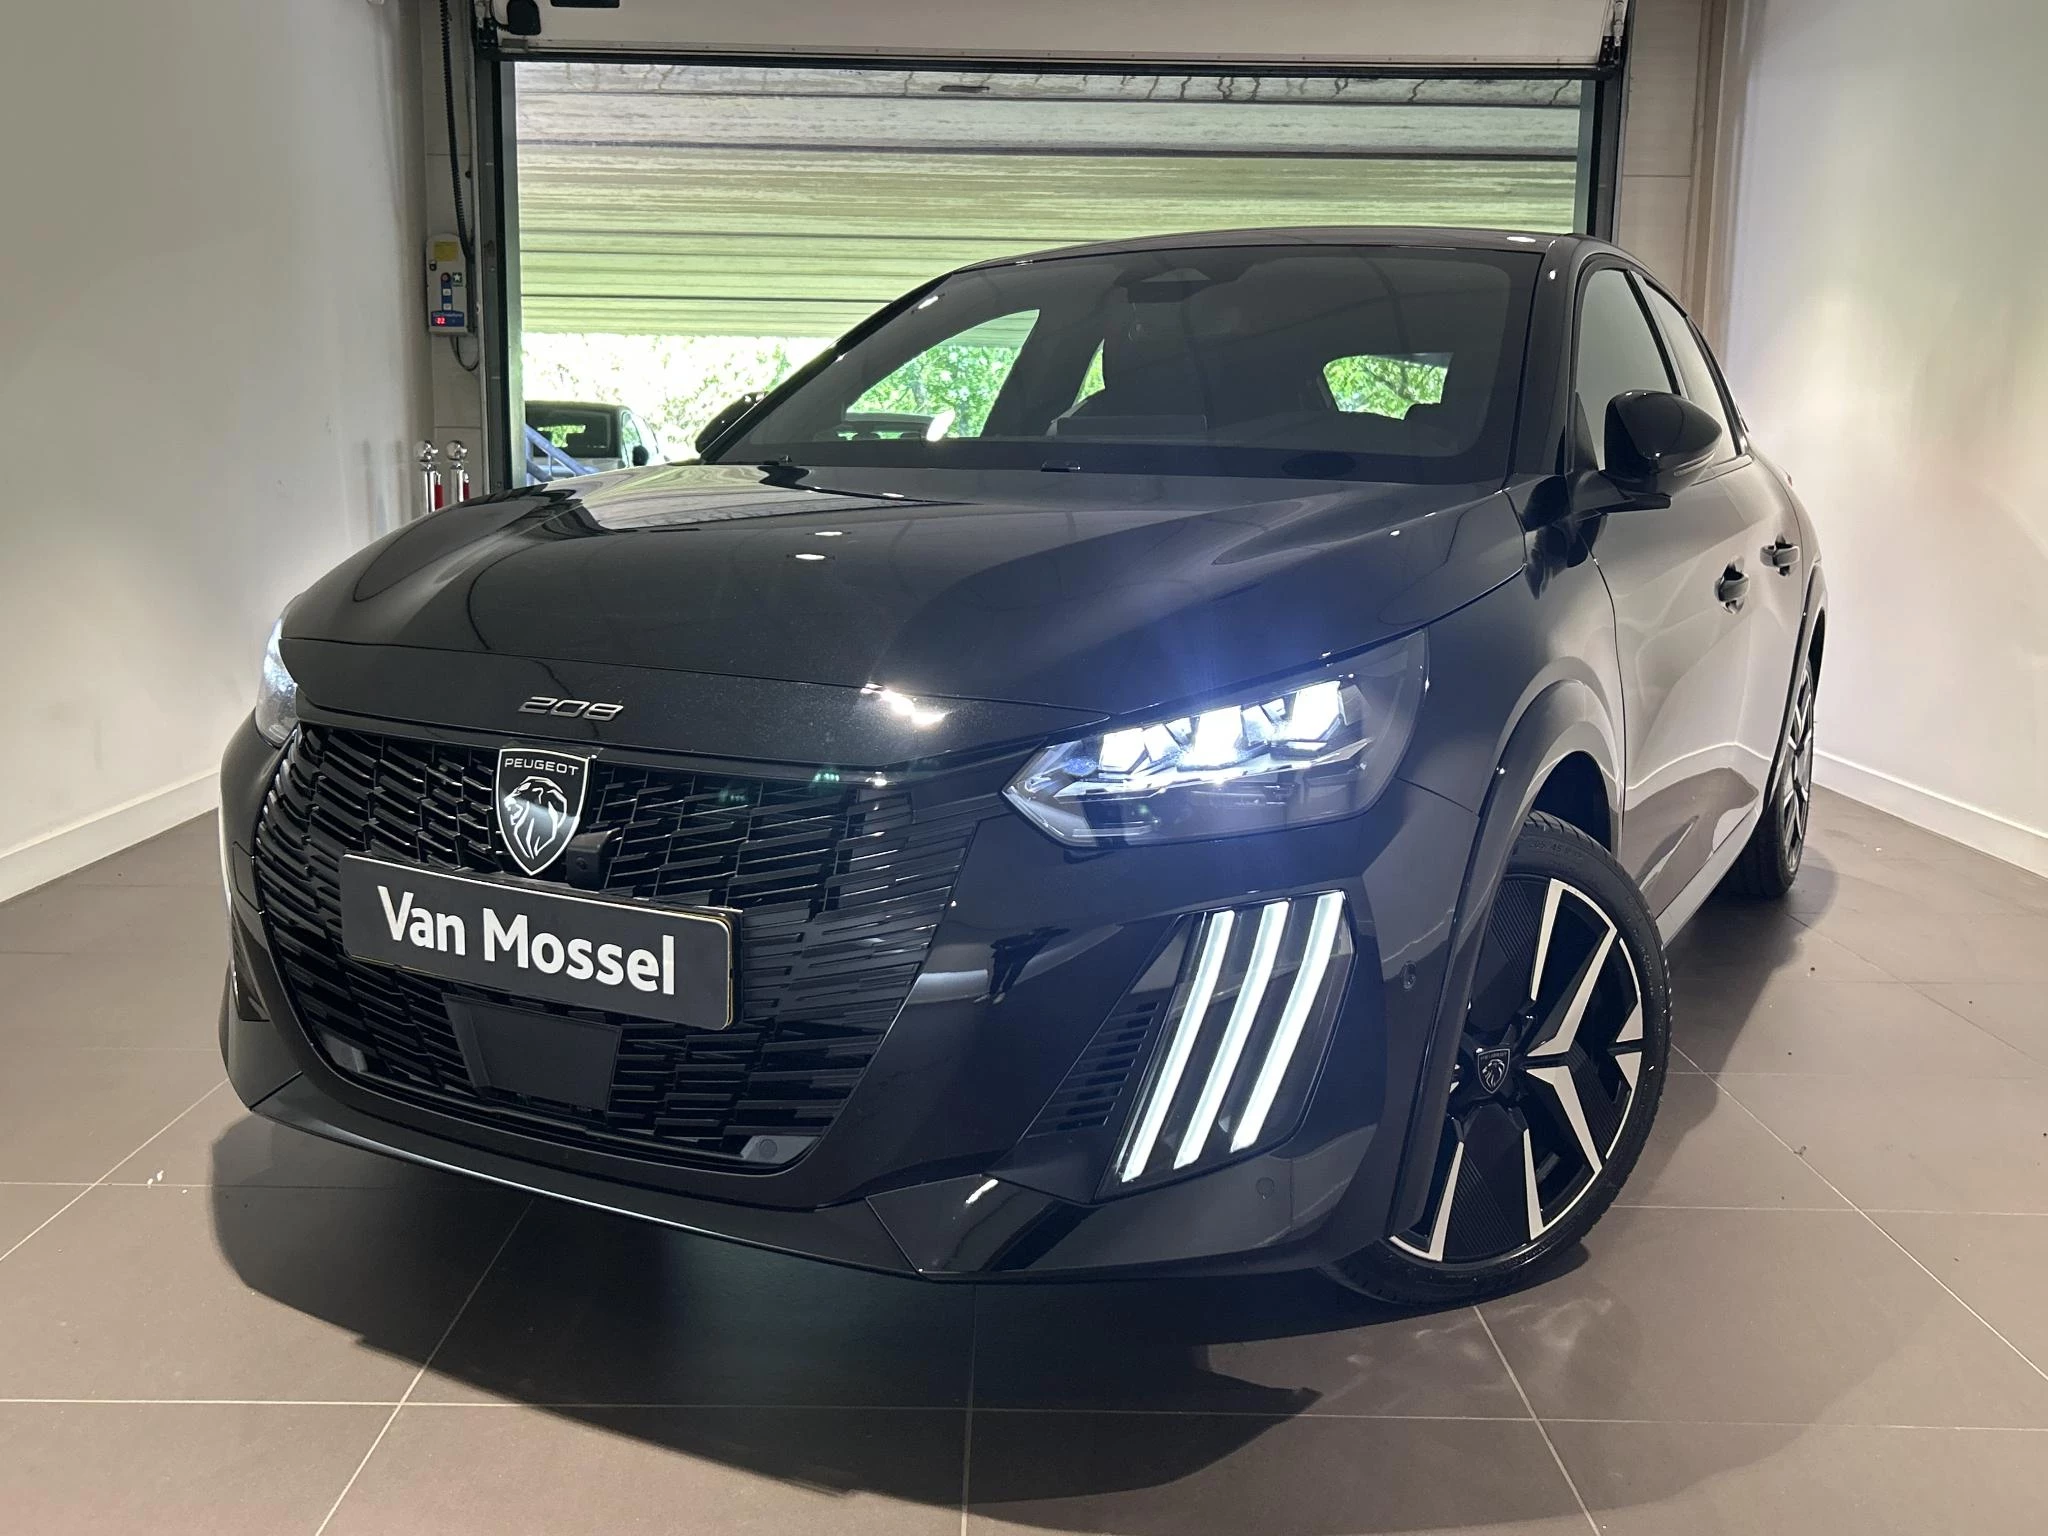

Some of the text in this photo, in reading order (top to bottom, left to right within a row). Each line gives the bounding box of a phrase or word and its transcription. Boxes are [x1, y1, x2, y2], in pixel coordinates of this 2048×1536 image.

[518, 696, 624, 721] 208
[504, 758, 579, 776] PEUGEOT
[377, 886, 675, 995] Van Mossel
